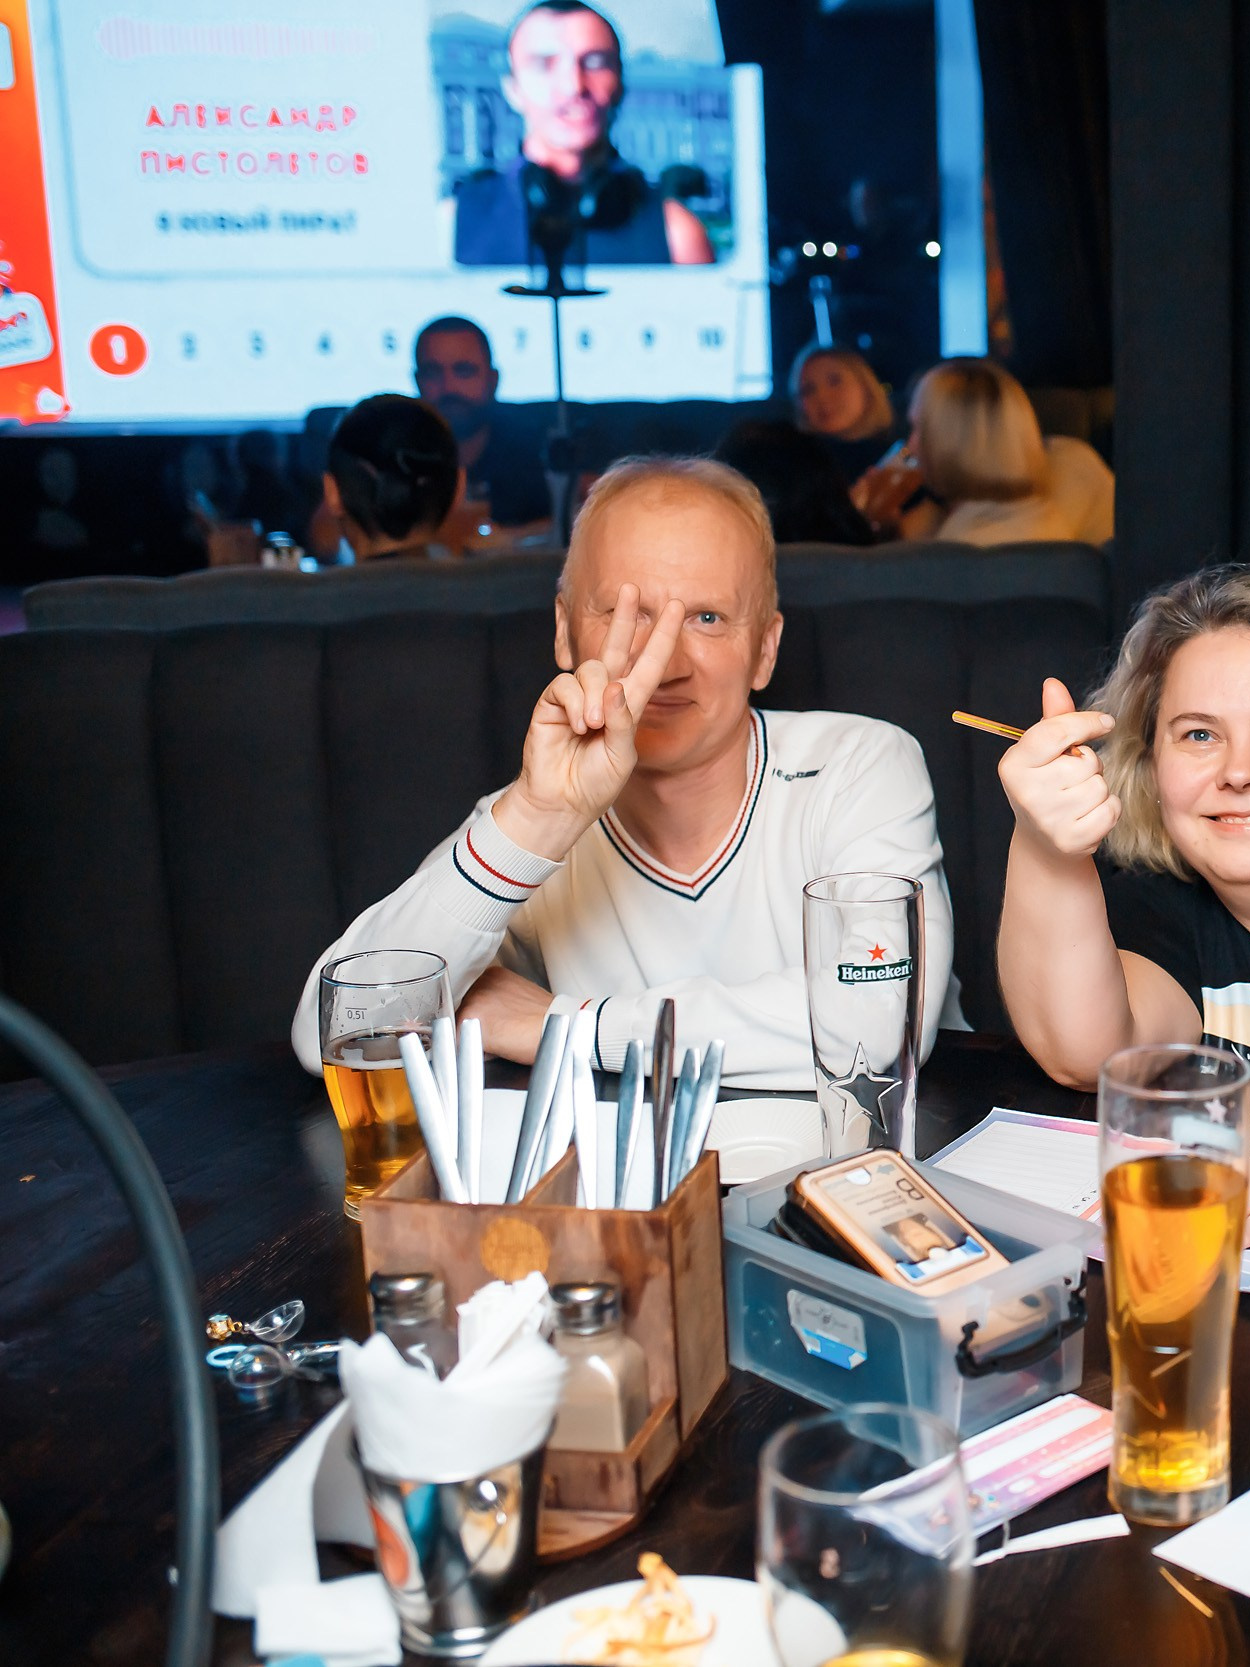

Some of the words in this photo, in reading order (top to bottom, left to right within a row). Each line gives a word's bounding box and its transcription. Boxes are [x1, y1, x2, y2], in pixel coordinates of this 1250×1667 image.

[146, 103, 357, 132] АЛЕКСАНДР
[140, 150, 369, 175] ПИСТОЛЕТОВ
[841, 963, 910, 981] Heineken
